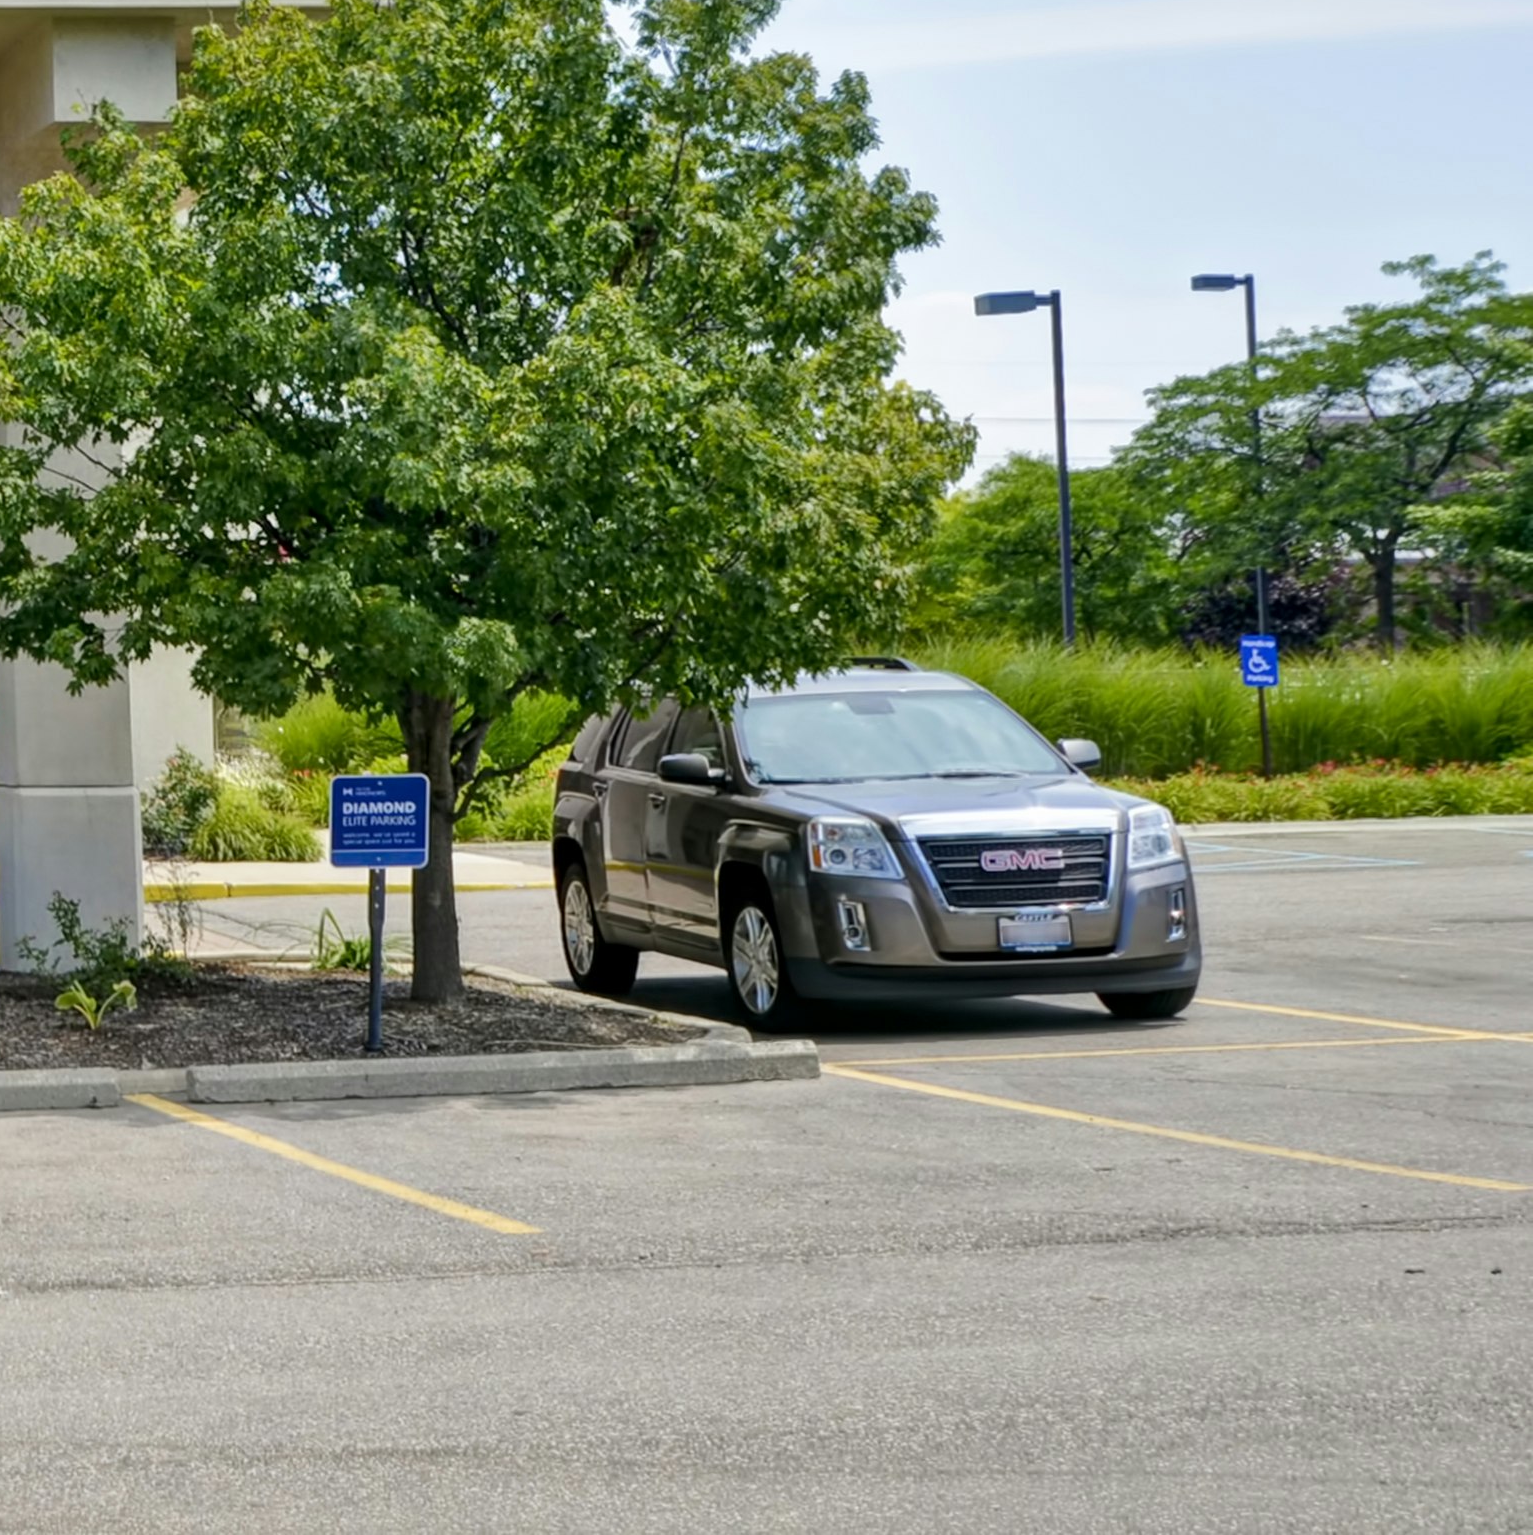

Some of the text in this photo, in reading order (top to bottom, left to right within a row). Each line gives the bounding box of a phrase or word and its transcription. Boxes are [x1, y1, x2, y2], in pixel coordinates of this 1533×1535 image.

[343, 801, 416, 815] DIAMOND
[343, 815, 416, 826] ELITE PARKING
[981, 848, 1065, 871] GMC
